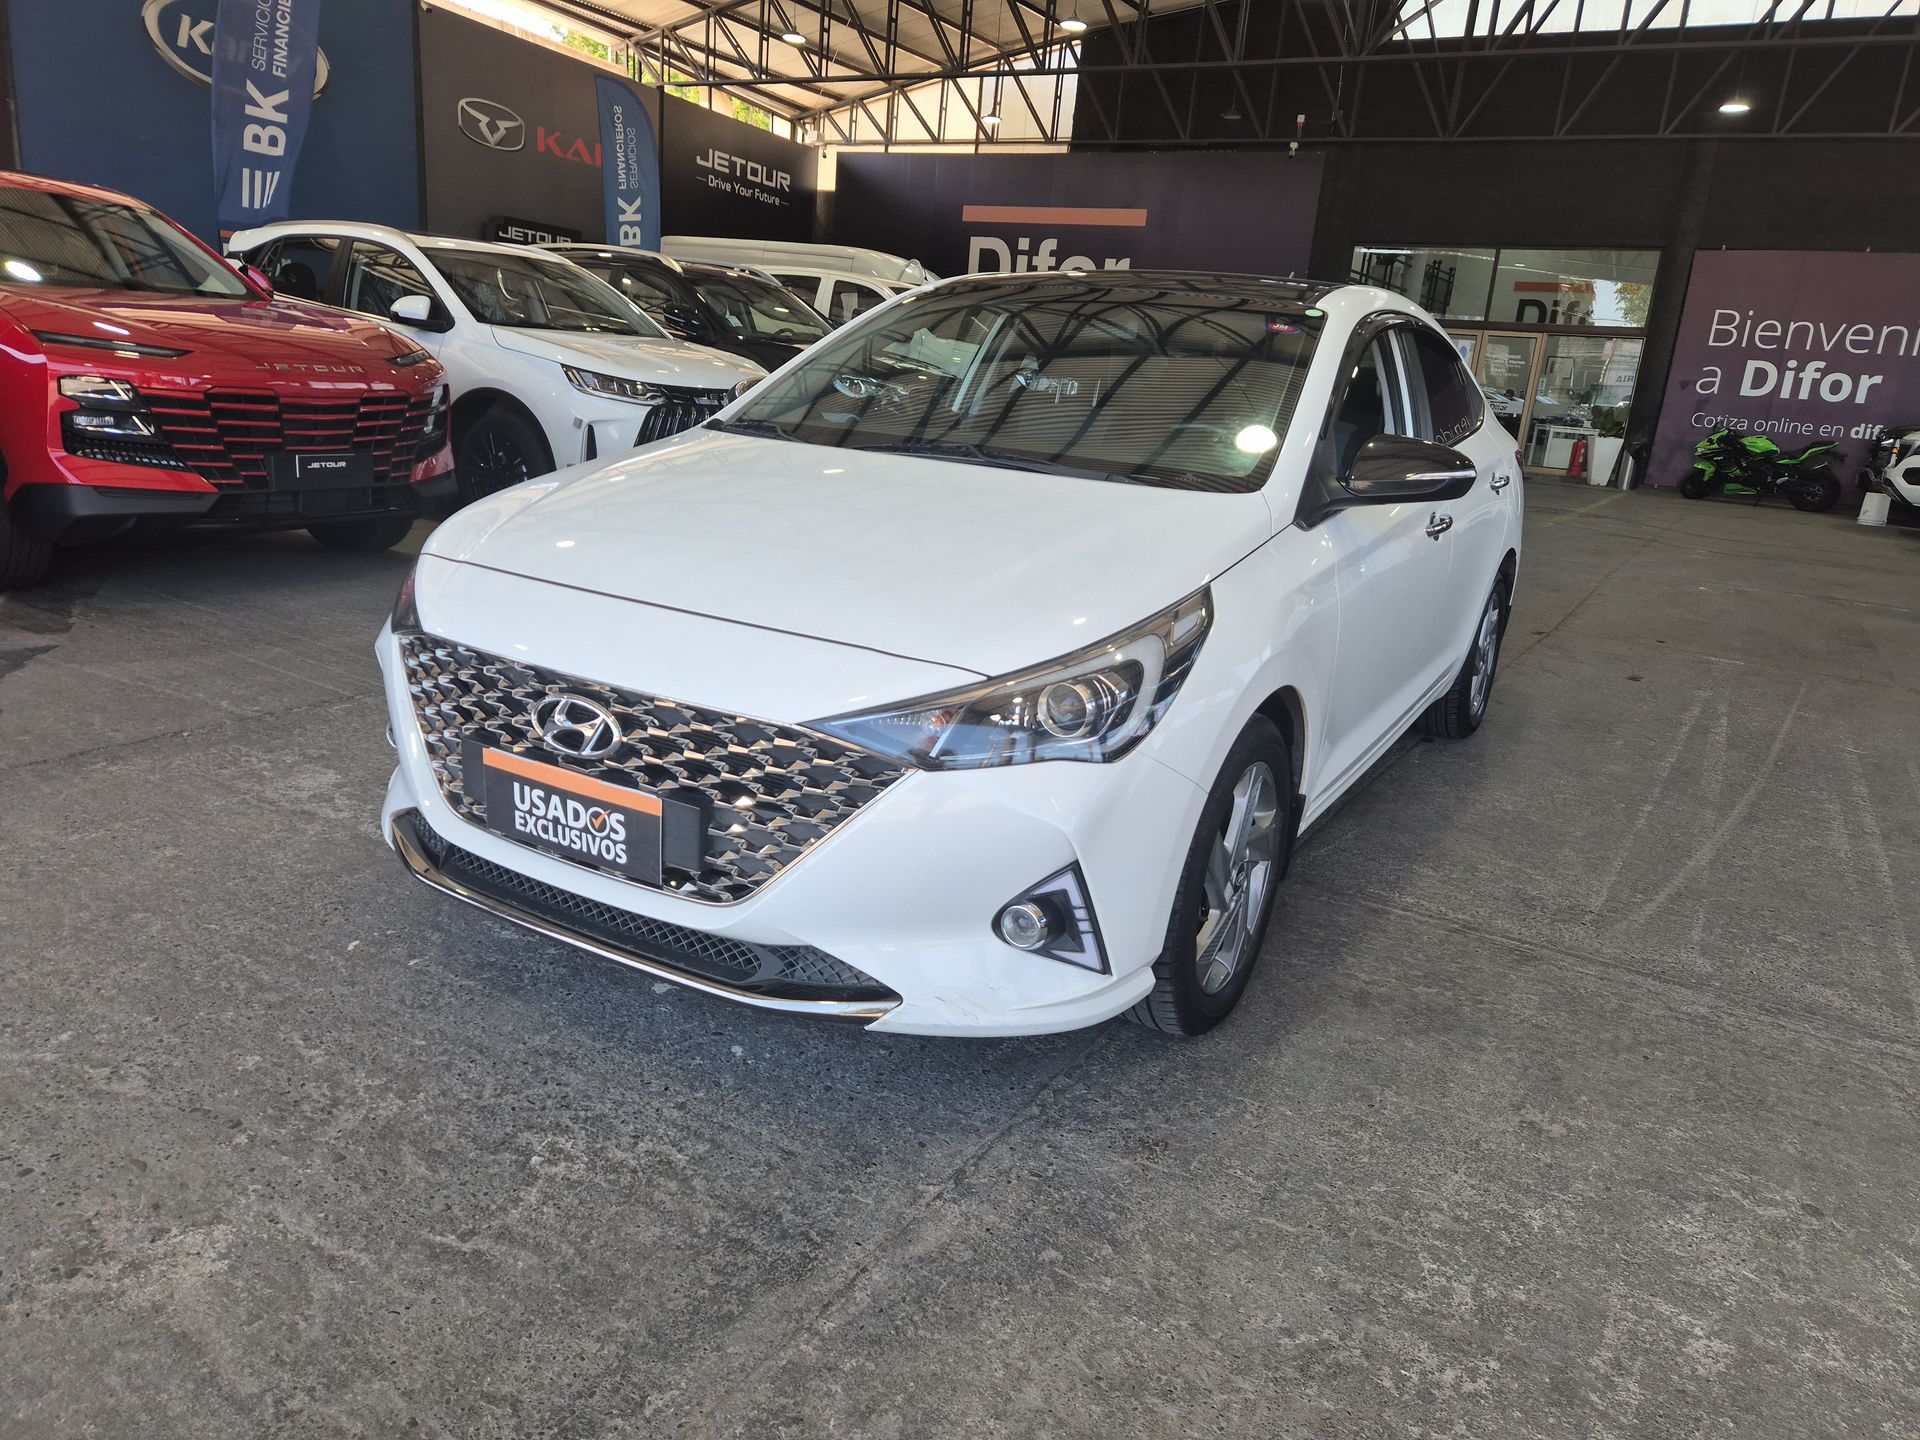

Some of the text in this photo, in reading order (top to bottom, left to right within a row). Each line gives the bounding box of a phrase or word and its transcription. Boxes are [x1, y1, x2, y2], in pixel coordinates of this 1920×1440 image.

[243, 78, 290, 156] BK
[696, 148, 791, 193] JETOUR
[708, 174, 780, 206] Drive Your Future
[617, 196, 642, 247] BK
[967, 236, 1131, 273] Dif
[256, 362, 365, 373] JETOUR
[1695, 359, 1883, 404] a Difor
[1691, 411, 1748, 430] Cotiza
[1753, 417, 1814, 435] online
[1819, 423, 1844, 437] en
[307, 461, 347, 469] JETOUR
[513, 781, 627, 842] USADOS
[514, 810, 628, 865] EXCLUSIVOS
